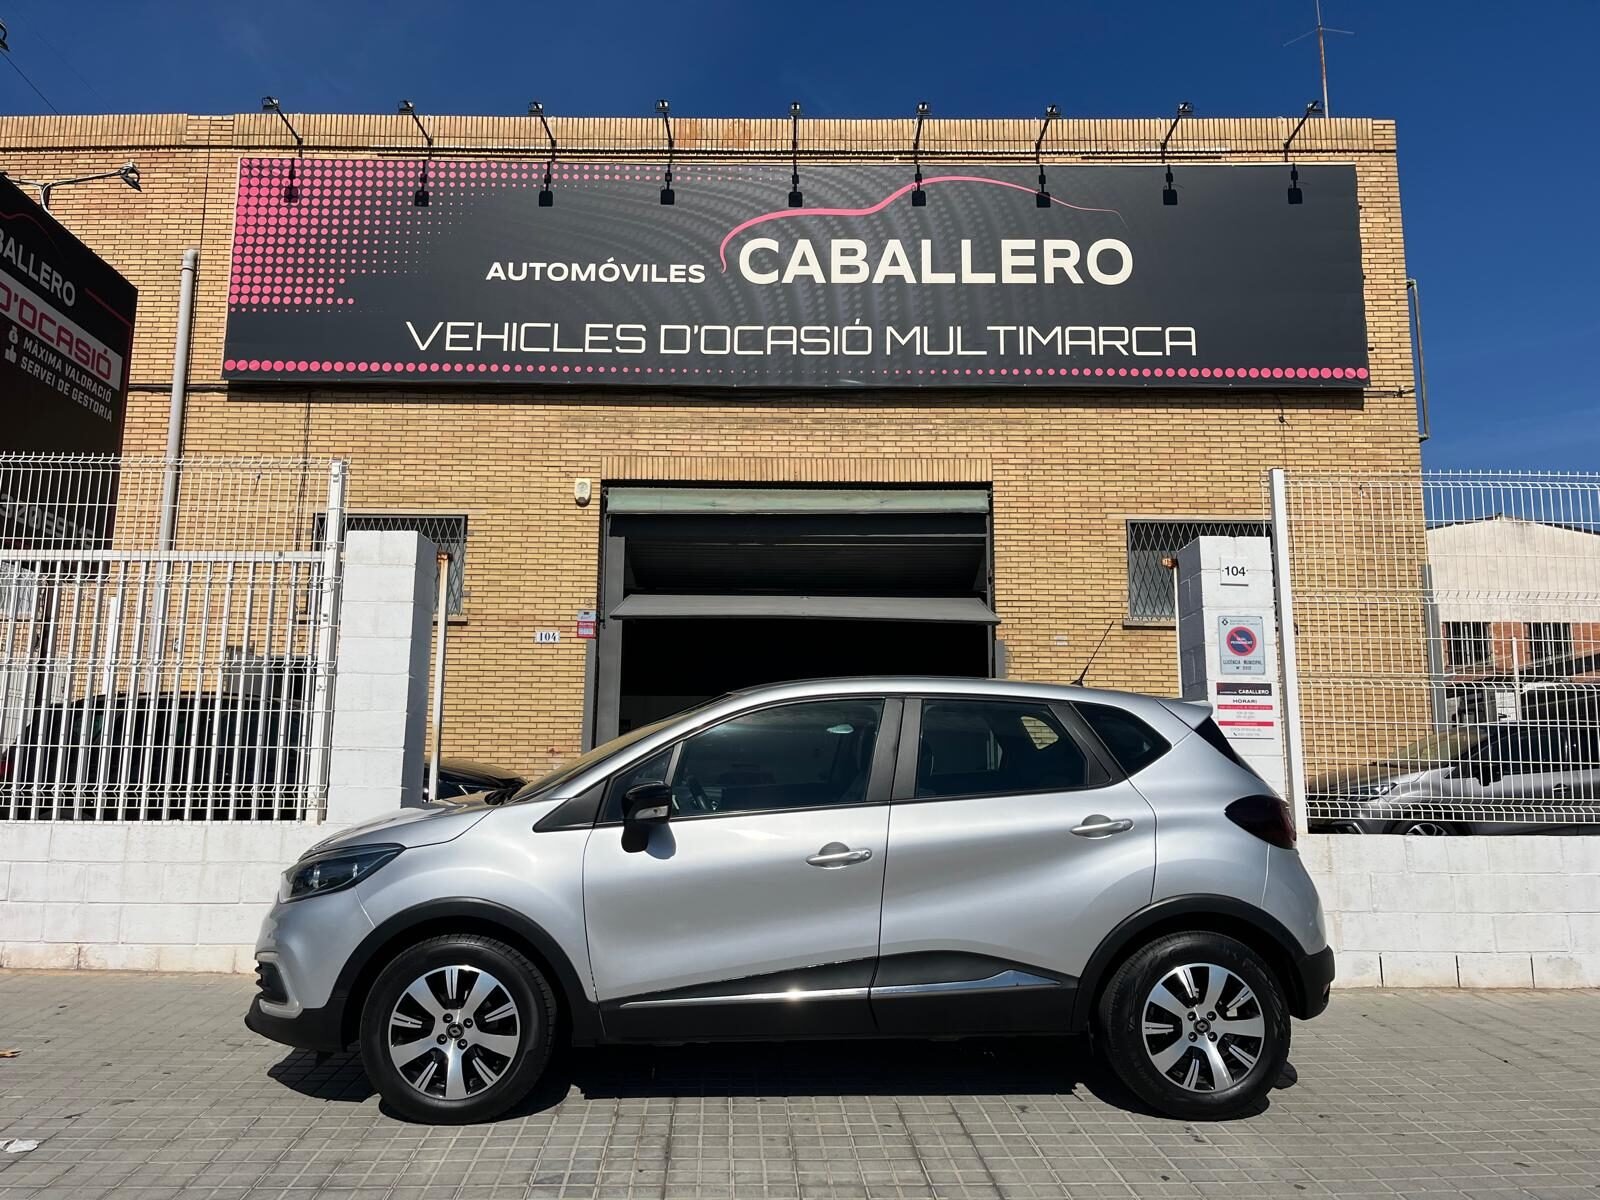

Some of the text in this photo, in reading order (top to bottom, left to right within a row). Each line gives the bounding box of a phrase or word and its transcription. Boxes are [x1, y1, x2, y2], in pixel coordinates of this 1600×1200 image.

[485, 238, 1134, 286] AUTOMÓVILES CABALLERO
[405, 318, 1198, 357] VEHICLES D'OCASIÓ MULTIMARCA
[20, 356, 112, 423] SERVEI DE GESTORIA
[64, 362, 112, 403] VALORACIÓ
[540, 632, 556, 641] 104
